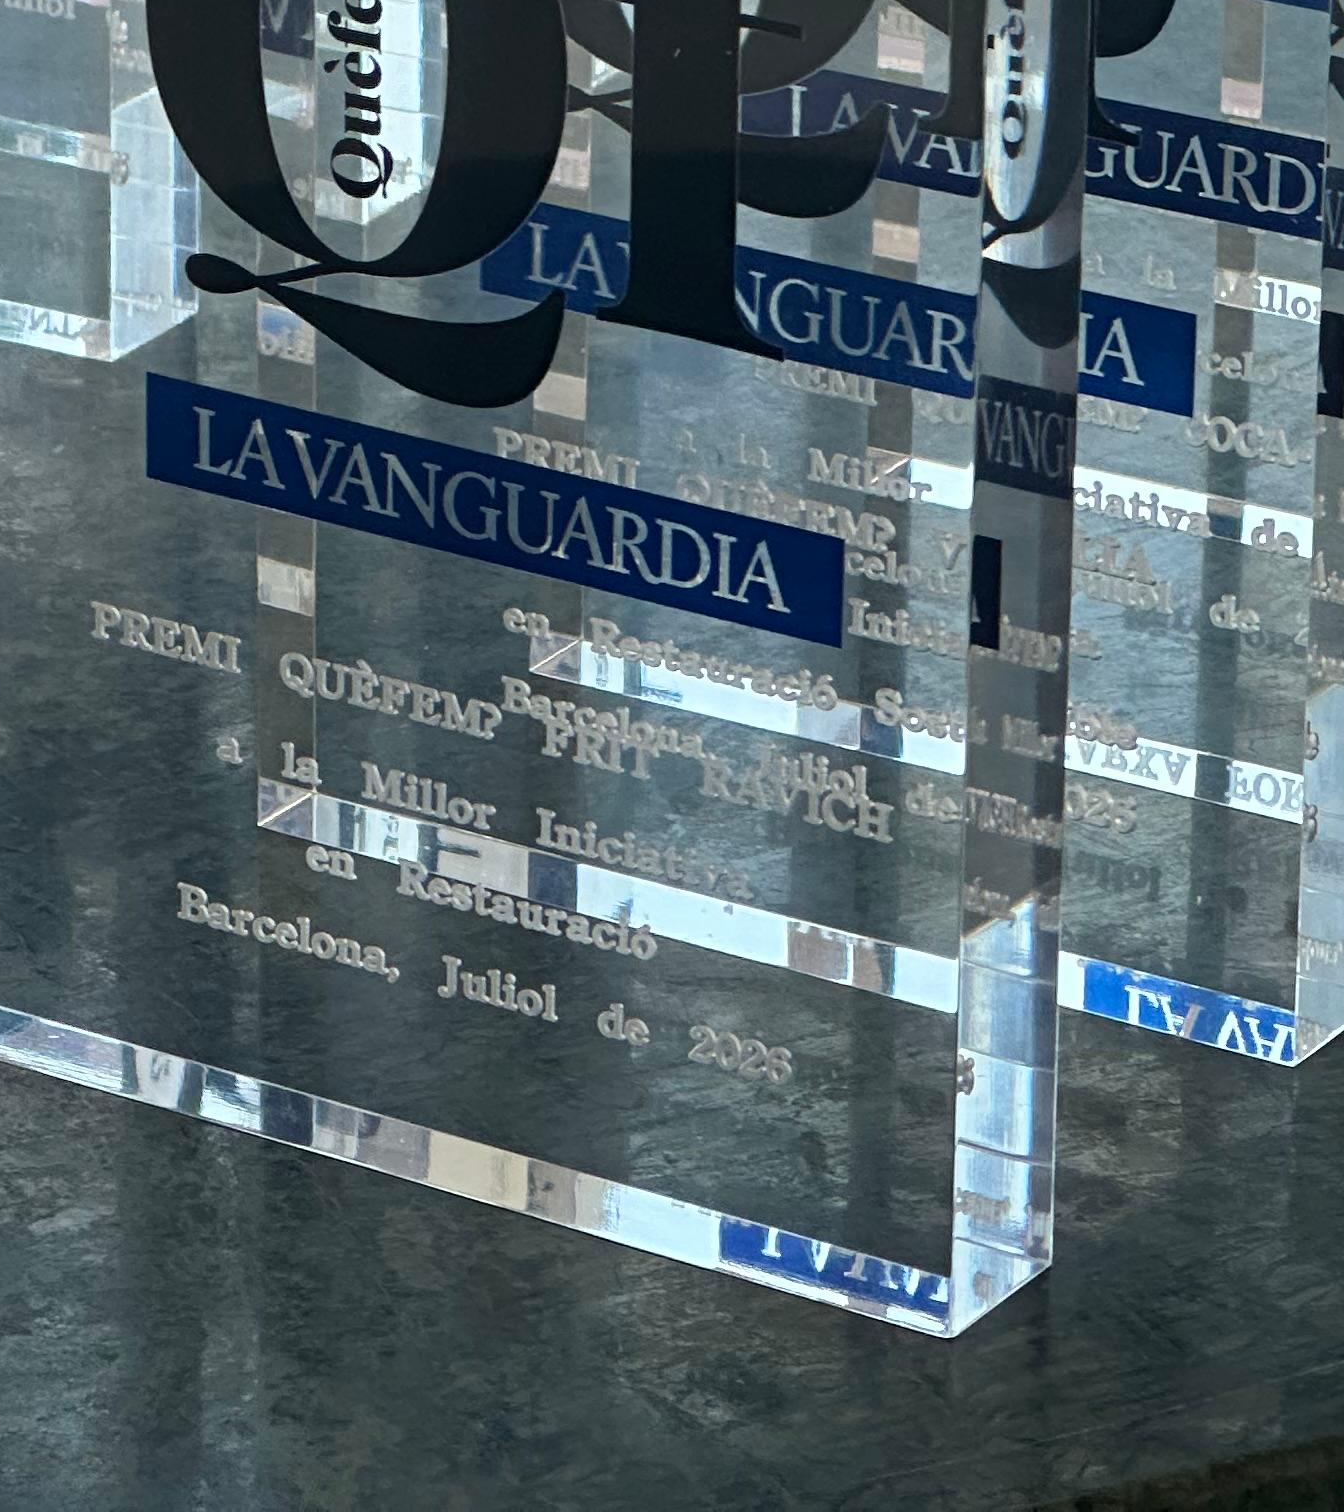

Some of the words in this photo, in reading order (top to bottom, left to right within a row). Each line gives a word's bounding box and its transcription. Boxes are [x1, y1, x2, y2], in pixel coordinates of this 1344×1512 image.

[1250, 517, 1301, 557] de
[88, 599, 244, 675] PREMI
[277, 650, 504, 743] QUÈFEM?
[541, 721, 654, 781] FRIT
[702, 762, 896, 845] RAVICH
[502, 605, 553, 642] en
[588, 615, 840, 713] Restauració
[216, 735, 245, 768] a
[281, 741, 324, 788] la
[360, 760, 499, 832] Millor
[534, 808, 756, 902] Iniciativa
[500, 674, 712, 764] Barcelona,
[756, 742, 869, 800] Juliol
[905, 784, 960, 823] de
[305, 841, 359, 883] en
[395, 858, 661, 964] Restauració
[176, 881, 404, 987] Barcelona,
[436, 954, 561, 1023] Juliol
[596, 1001, 653, 1047] de
[685, 1023, 798, 1086] 2026
